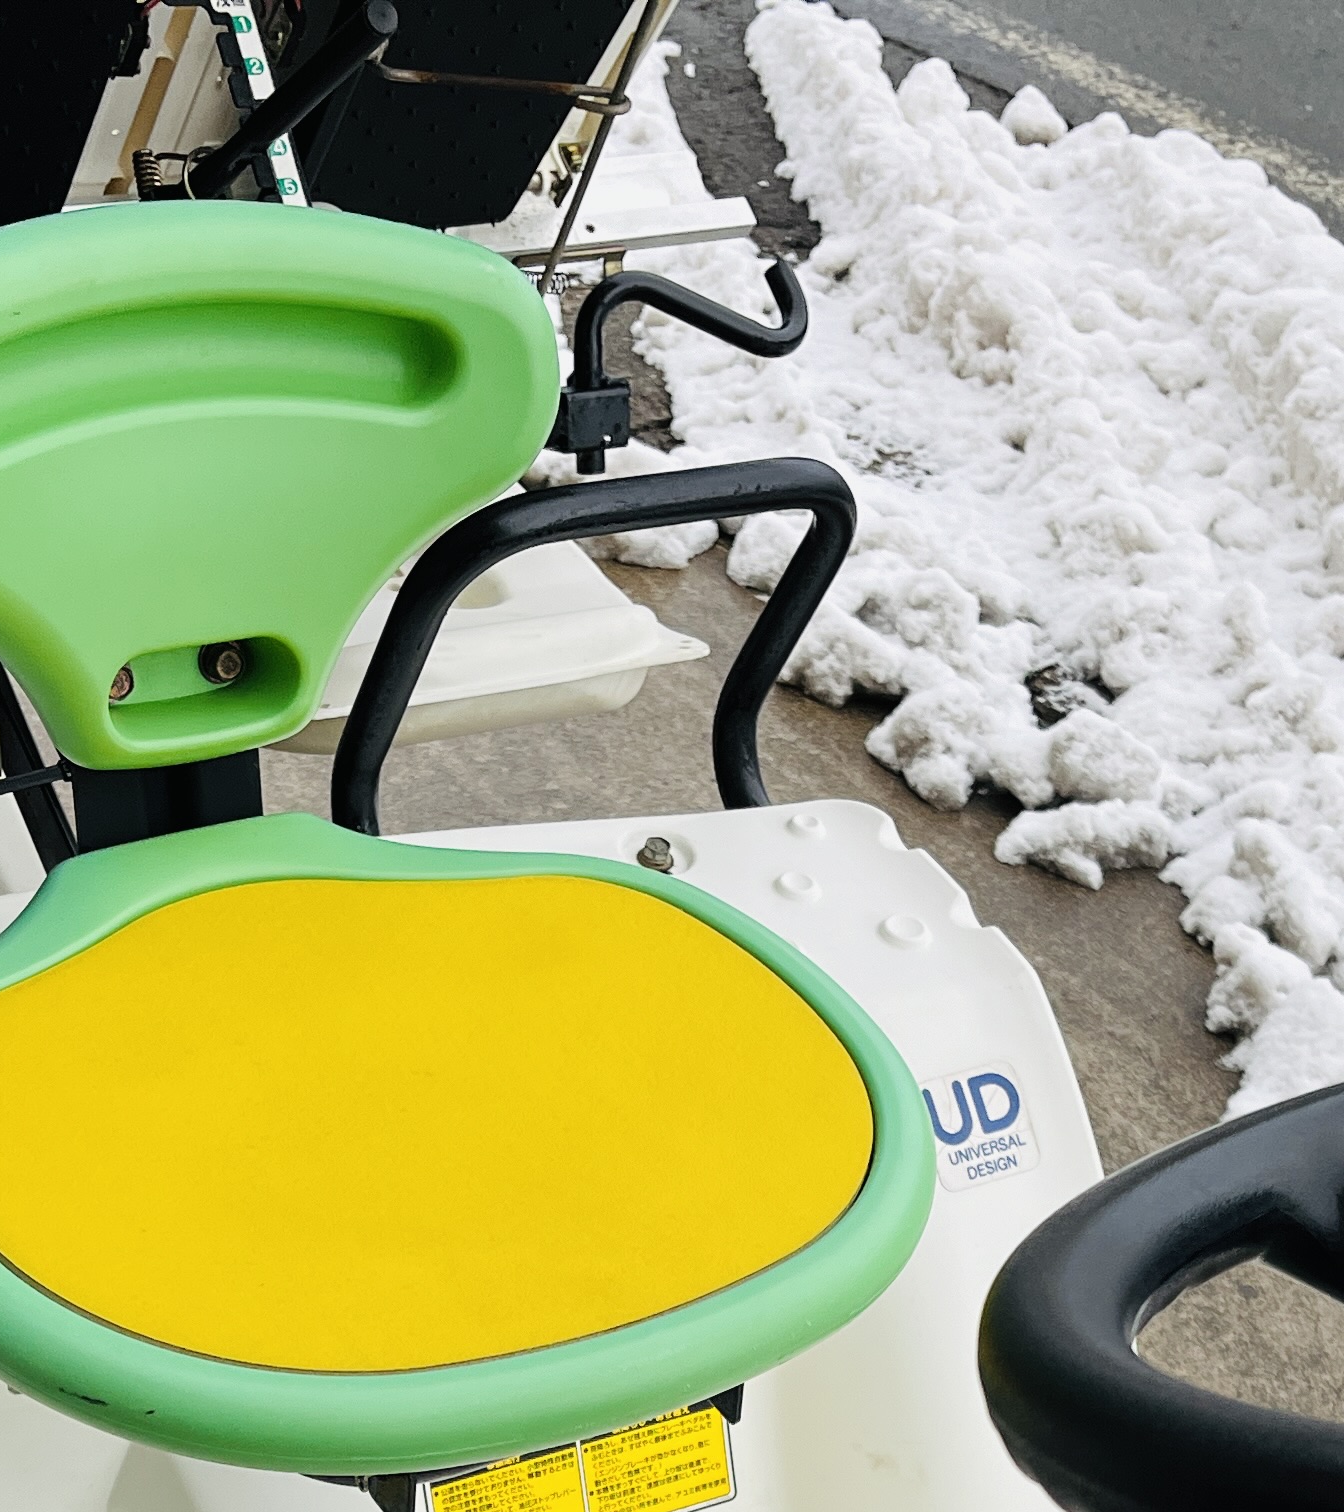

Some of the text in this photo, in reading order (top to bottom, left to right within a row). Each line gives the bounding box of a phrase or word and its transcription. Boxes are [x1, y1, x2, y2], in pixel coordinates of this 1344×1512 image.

[238, 16, 249, 33] 1
[249, 58, 262, 75] 2
[273, 139, 286, 156] 4
[285, 178, 299, 195] 5
[922, 1072, 1020, 1146] UD
[948, 1133, 1026, 1166] UNIVERSAL
[967, 1154, 1018, 1180] DESIGN
